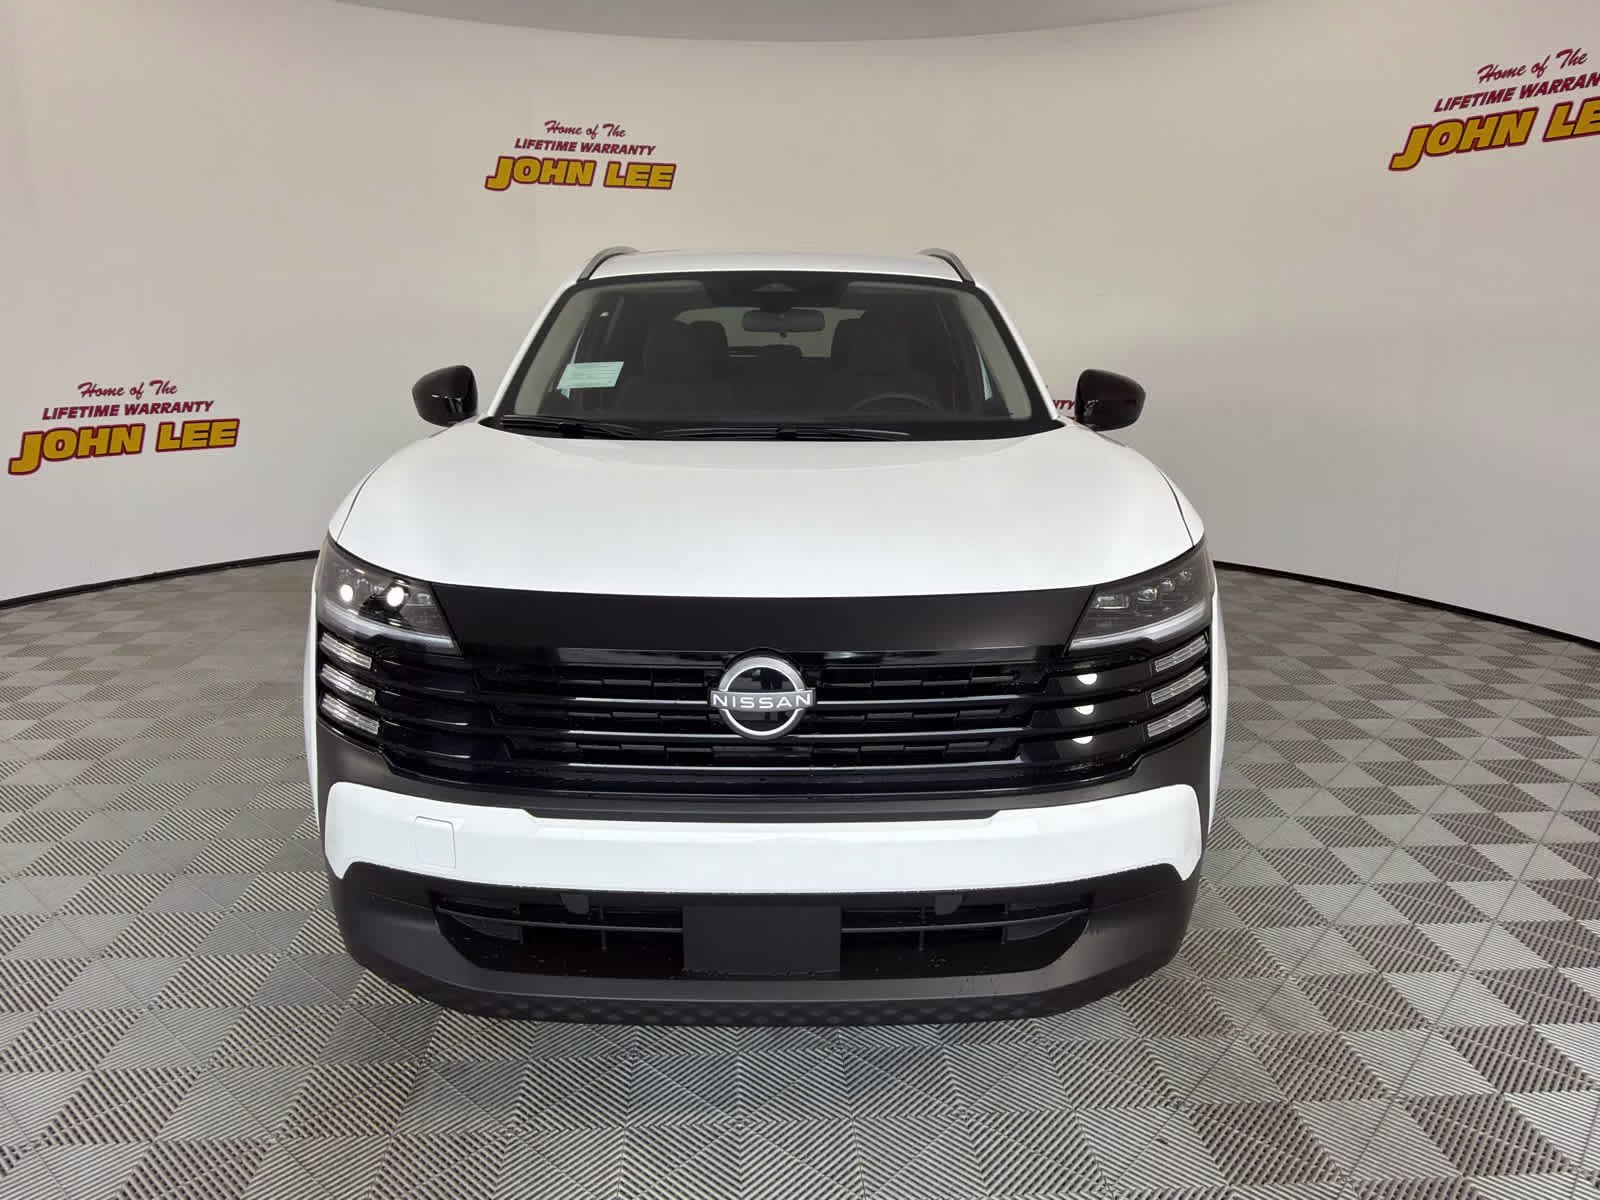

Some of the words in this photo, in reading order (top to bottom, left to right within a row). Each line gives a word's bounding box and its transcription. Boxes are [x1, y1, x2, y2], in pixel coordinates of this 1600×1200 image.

[1477, 64, 1527, 84] Home
[1530, 54, 1551, 78] of
[1556, 48, 1588, 69] The
[1433, 87, 1517, 113] LIFETIME
[544, 120, 583, 135] Home
[585, 124, 599, 139] of
[602, 123, 626, 138] The
[1388, 107, 1539, 171] JOHN
[514, 138, 578, 152] LIFETIME
[580, 142, 656, 156] WARRANTY
[484, 156, 597, 191] JOHN
[603, 161, 677, 190] LEE
[77, 382, 125, 397] Home
[129, 382, 146, 400] of
[149, 380, 178, 396] The
[42, 404, 121, 420] LIFETIME
[124, 400, 215, 416] WARRANTY
[8, 423, 146, 476] JOHN
[155, 418, 240, 452] LEE
[712, 693, 812, 709] NISSAN
